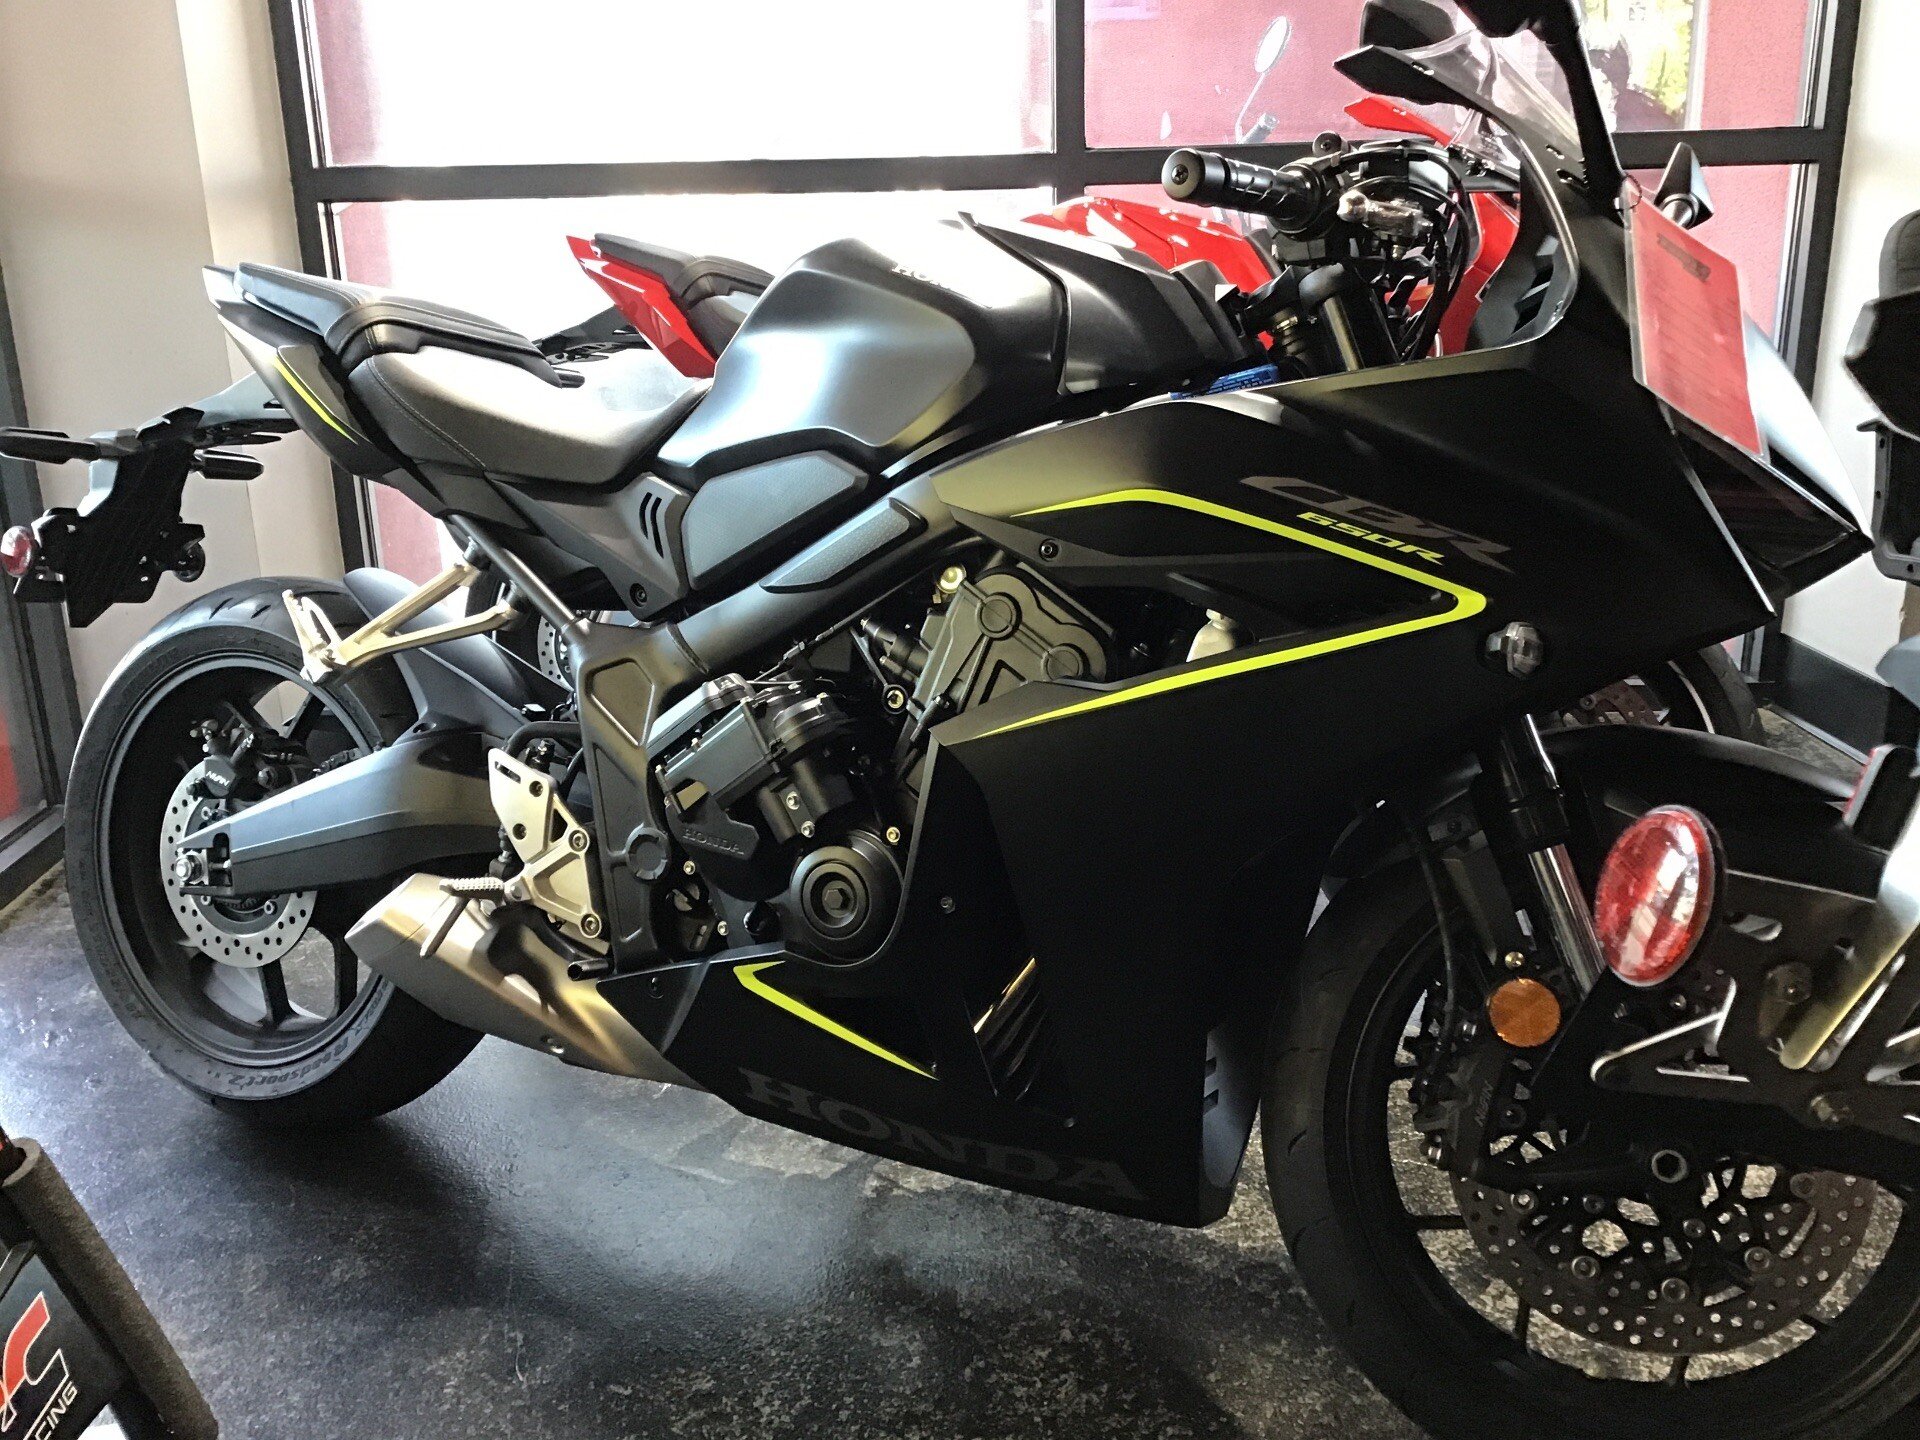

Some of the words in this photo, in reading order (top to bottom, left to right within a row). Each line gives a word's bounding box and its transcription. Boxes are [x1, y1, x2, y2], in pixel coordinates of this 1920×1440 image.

[1240, 475, 1515, 574] CBR
[1297, 511, 1446, 566] 650R
[682, 826, 745, 856] HONDA
[738, 1066, 1147, 1202] HONDA
